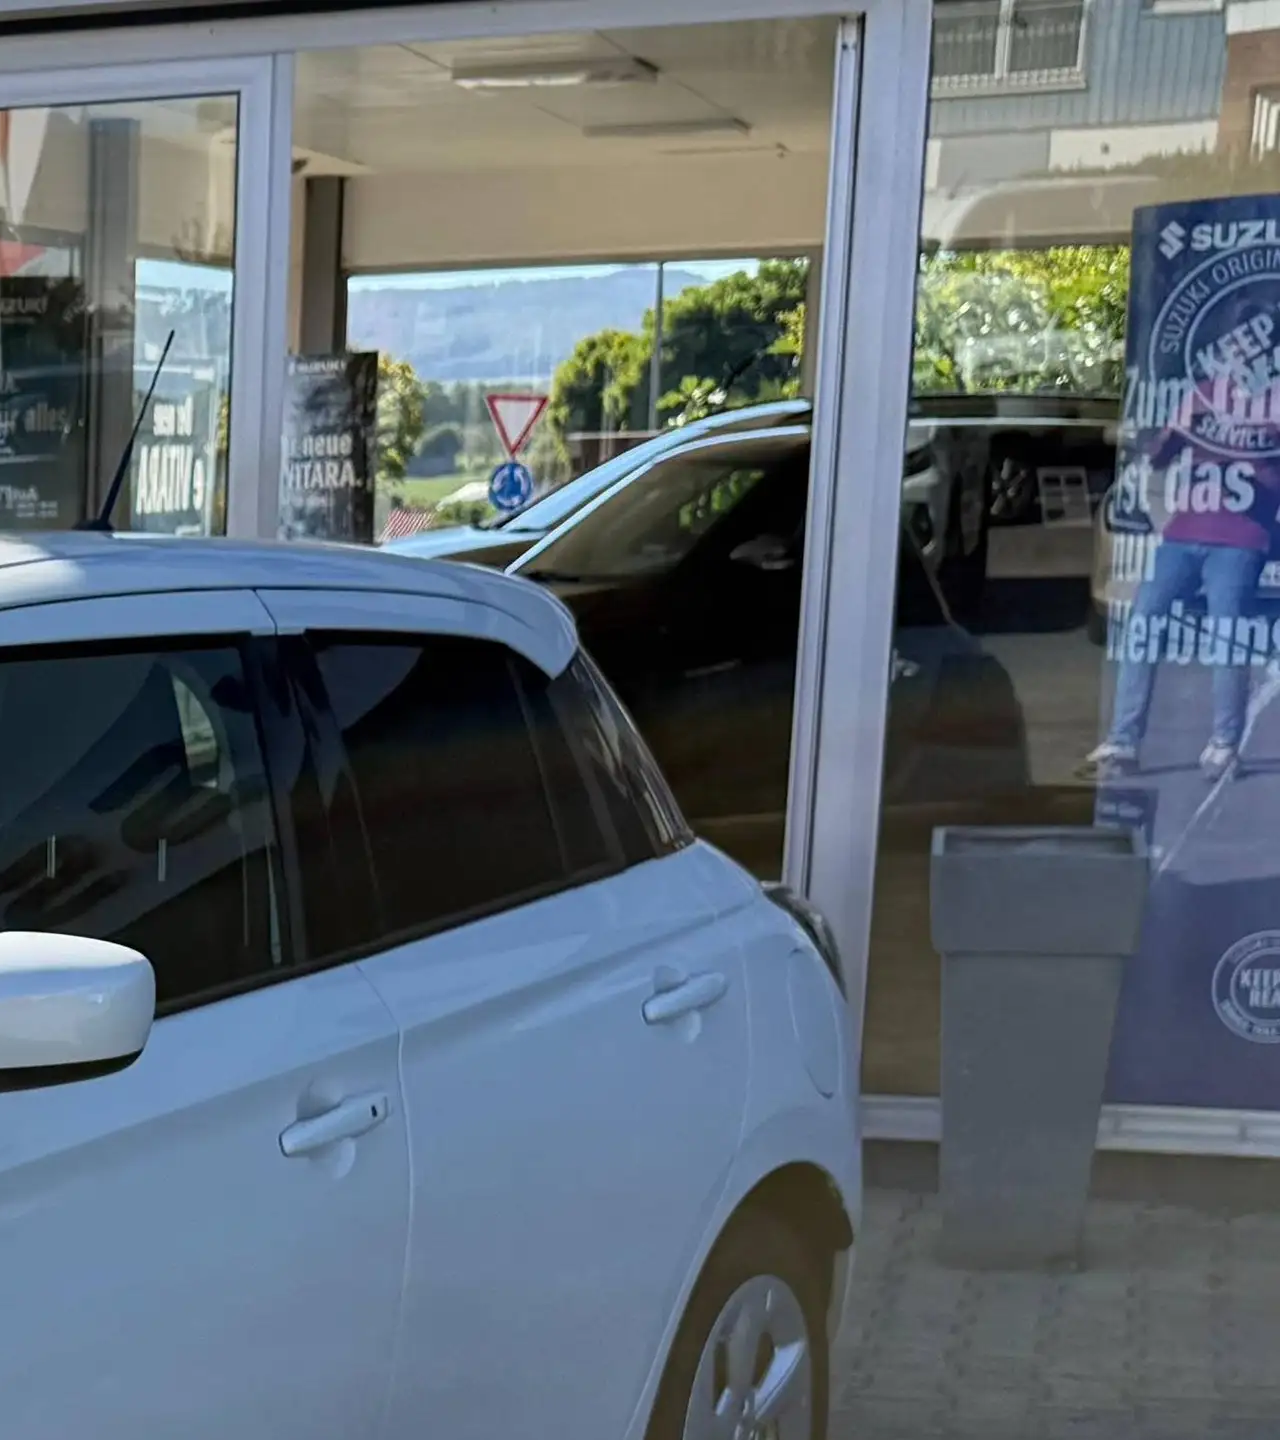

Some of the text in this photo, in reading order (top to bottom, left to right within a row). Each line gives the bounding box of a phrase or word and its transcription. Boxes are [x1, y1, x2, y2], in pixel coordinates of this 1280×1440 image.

[1160, 284, 1210, 354] SUZUKI
[303, 433, 352, 457] neue
[1165, 447, 1255, 512] das
